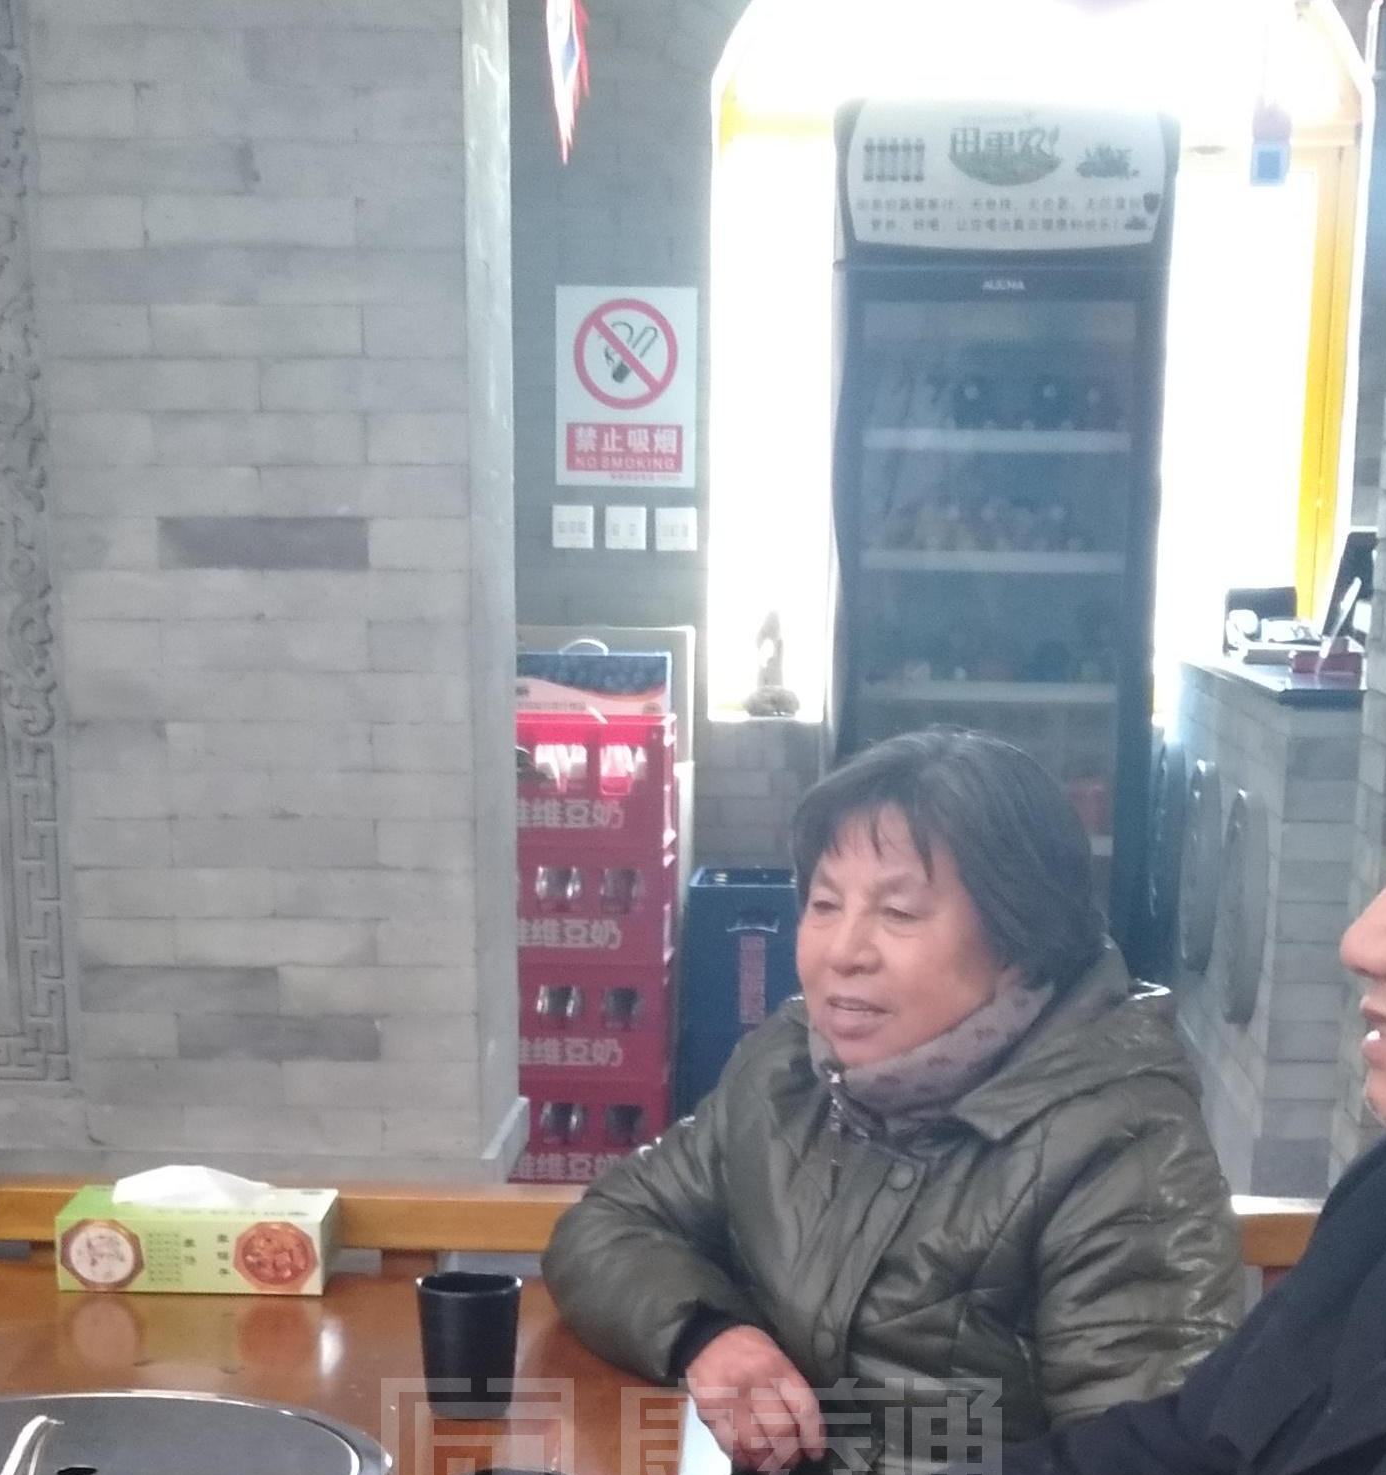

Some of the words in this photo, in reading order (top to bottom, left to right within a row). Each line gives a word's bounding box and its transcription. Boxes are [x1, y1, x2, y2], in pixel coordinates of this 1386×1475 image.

[574, 426, 677, 454] 禁止吸烟
[574, 456, 597, 469] NO
[600, 456, 677, 471] SMOKING
